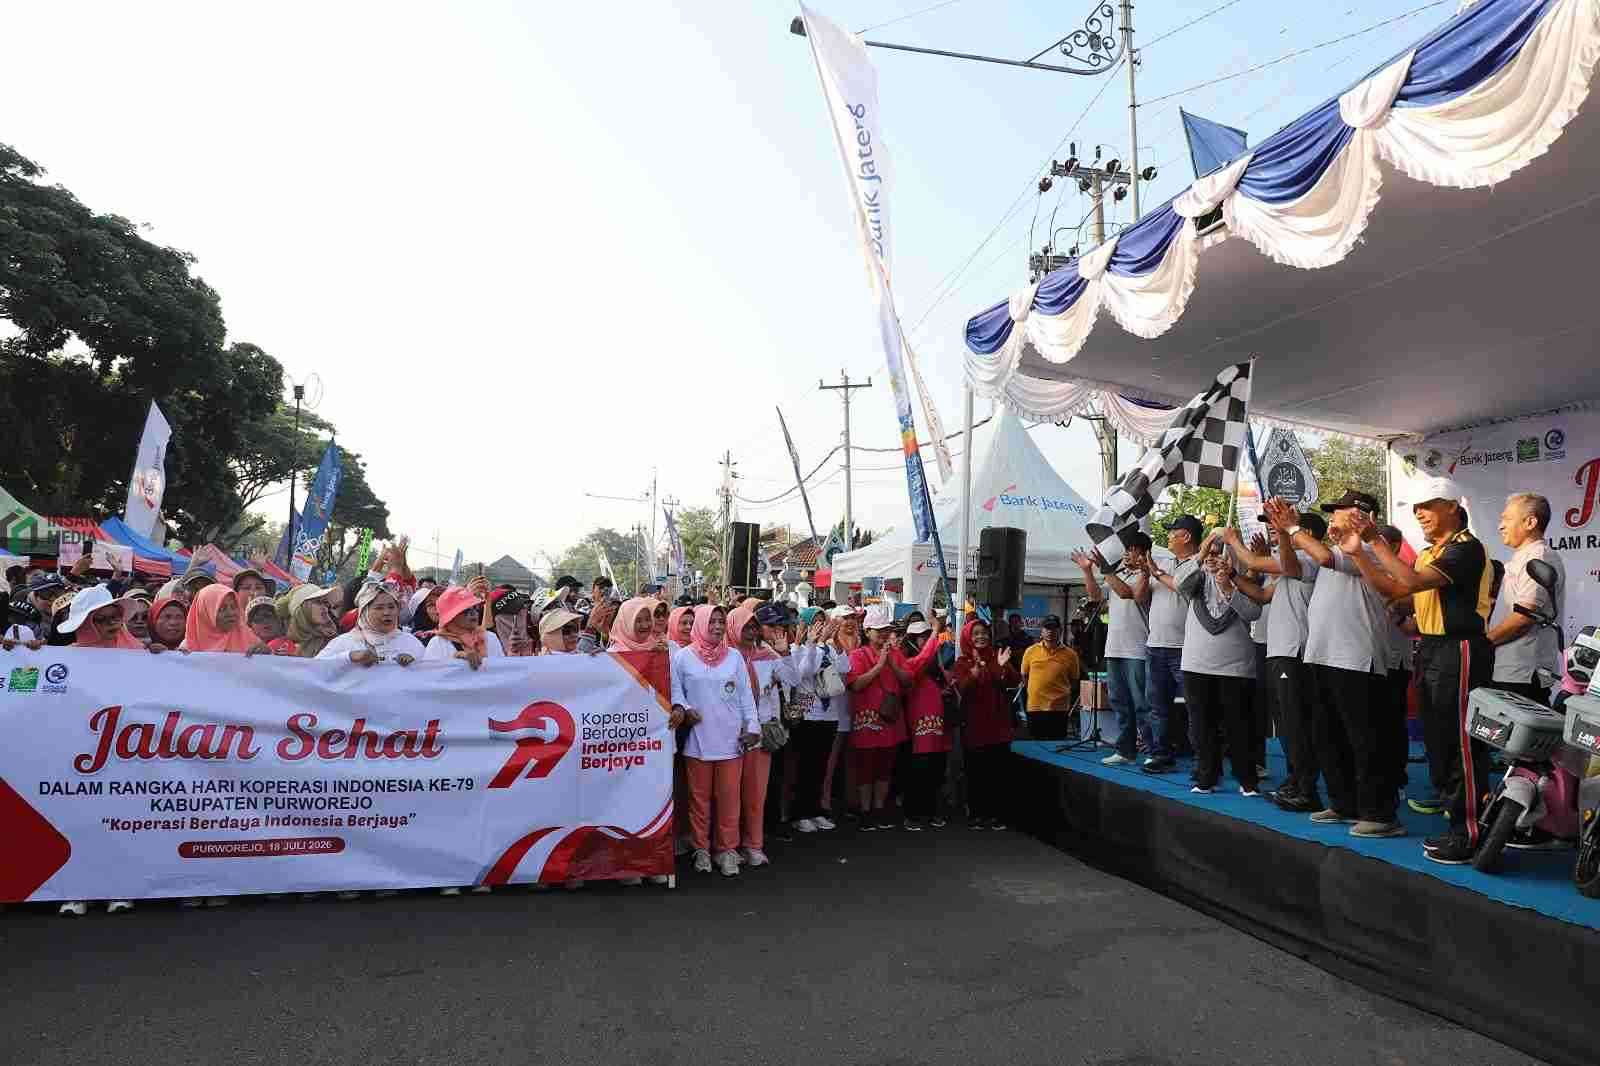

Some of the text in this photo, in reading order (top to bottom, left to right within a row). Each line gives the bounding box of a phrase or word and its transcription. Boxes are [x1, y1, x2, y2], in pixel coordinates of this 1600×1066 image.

[1549, 536, 1581, 551] LAM
[581, 709, 649, 726] Koperasi
[73, 704, 446, 775] Jalan Sehat
[582, 726, 647, 740] Berdaya
[581, 738, 662, 754] Indonesia
[581, 755, 644, 771] Berjaya
[39, 778, 474, 795] DALAM RANGKA HARI KOPERASI INDONESIA KE-79
[150, 796, 373, 812] KABUPATEN PURWOREJO
[190, 816, 260, 832] Berdaya
[265, 813, 343, 828] Indonesia
[192, 840, 333, 855] PURWOREJO, 18 JULI 2026
